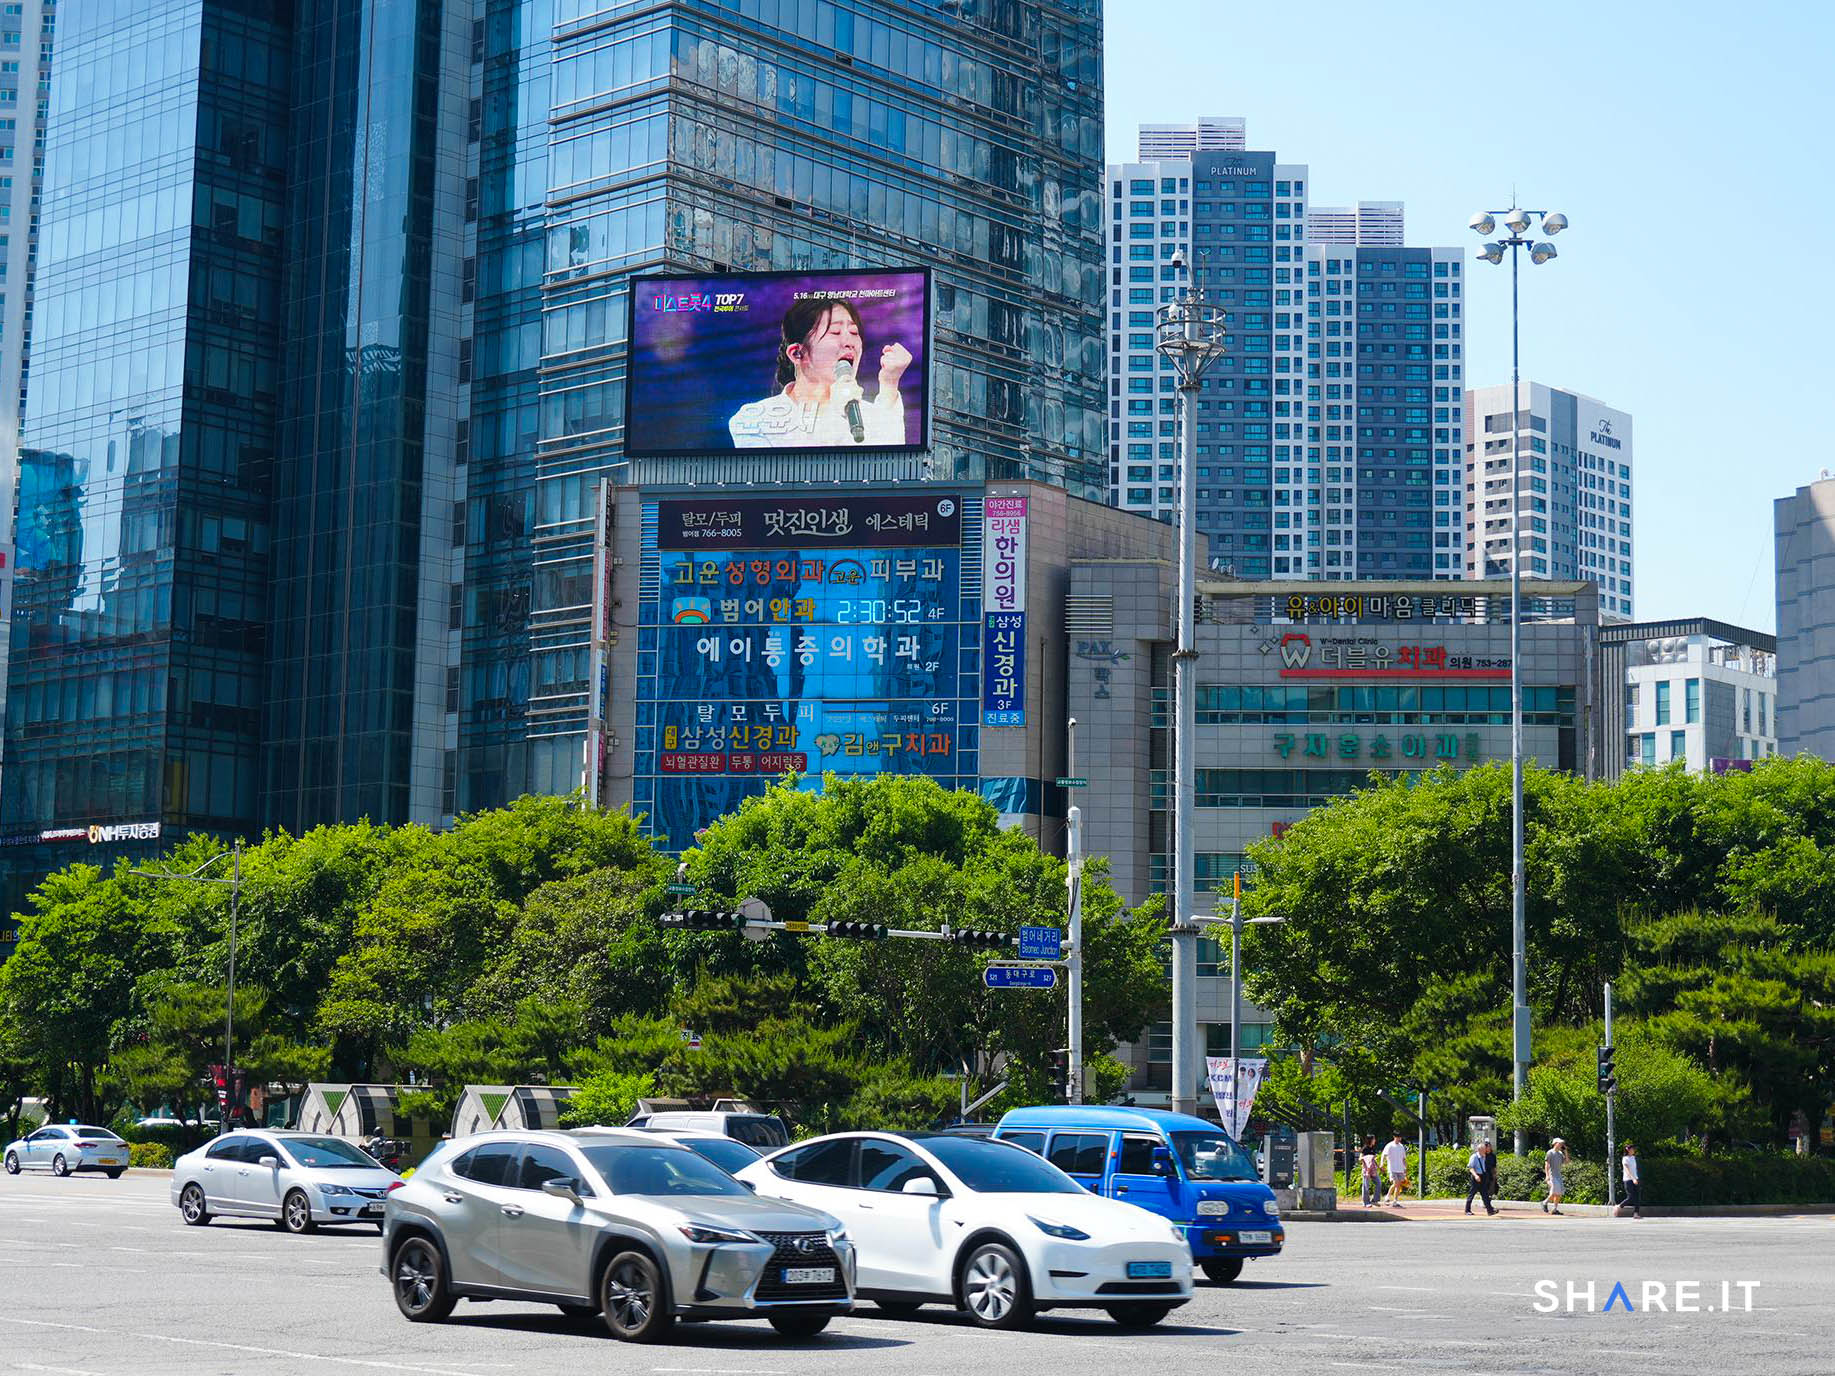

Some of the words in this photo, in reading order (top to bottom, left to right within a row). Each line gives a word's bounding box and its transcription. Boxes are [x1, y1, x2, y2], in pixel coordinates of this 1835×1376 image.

[1211, 167, 1257, 176] PLATINUM
[715, 293, 744, 306] TOP7
[793, 291, 808, 300] 5.16
[813, 291, 827, 300] 대구
[1598, 418, 1613, 436] The
[1590, 431, 1622, 450] PLATINUM
[940, 503, 952, 513] 6F
[989, 500, 1023, 509] 야간진료
[682, 511, 742, 527] 탈모/두피
[763, 508, 853, 537] 멋진인생
[865, 512, 929, 532] 에스테틱
[701, 528, 742, 537] 766-8005
[991, 519, 1020, 535] 리샘
[674, 559, 825, 585] 고운성형외과
[831, 569, 862, 585] 고운
[870, 559, 945, 582] 피부과
[994, 536, 1019, 609] 한의원
[720, 598, 817, 622] 범어안과
[838, 600, 920, 624] 2:30:52
[927, 607, 945, 619] 4F
[1370, 595, 1413, 618] 마음
[1421, 597, 1475, 617] 클리닉
[996, 615, 1022, 628] 삼성
[1320, 637, 1355, 645] W-Dental
[696, 635, 920, 667] 에이통증의학과
[925, 661, 940, 672] 2F
[993, 631, 1018, 698] 신경과
[1450, 657, 1472, 669] 의원
[931, 702, 949, 715] 6F
[997, 700, 1012, 710] 3F
[987, 713, 1020, 724] 진료중
[680, 725, 800, 750] 삼성신경과
[844, 732, 951, 757] 김앤구치과
[665, 755, 720, 769] 뇌혈관질환
[731, 756, 753, 769] 두통
[761, 755, 804, 770] 어지럼증
[98, 821, 161, 842] NH투자증권
[1022, 930, 1058, 944] 범어네거리
[1006, 969, 1036, 979] 동대구로
